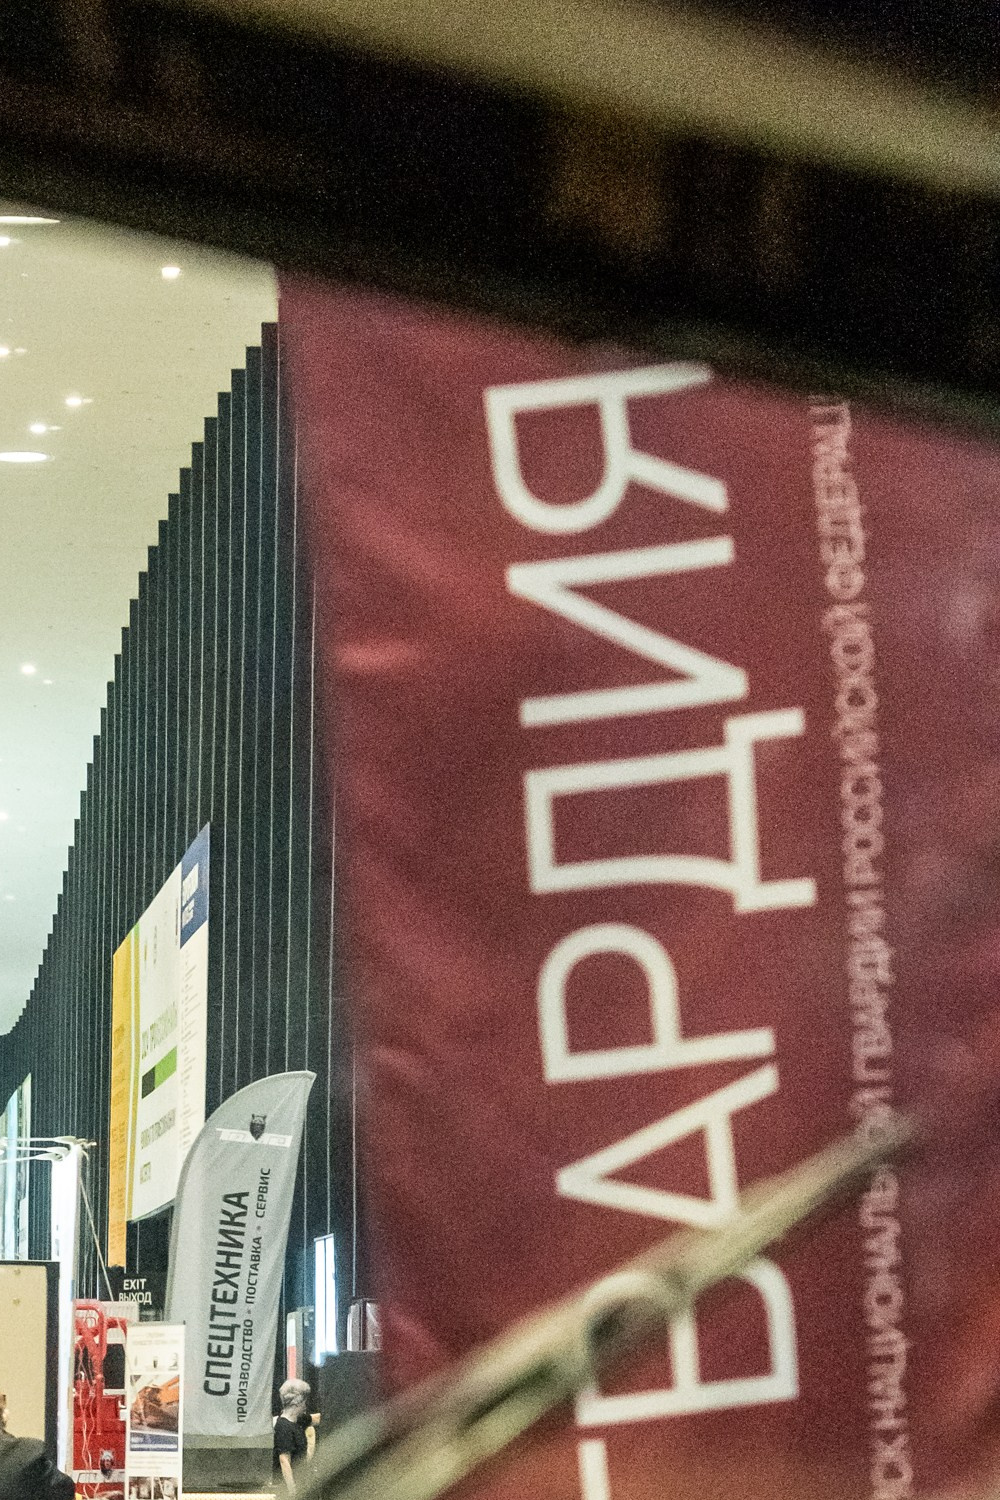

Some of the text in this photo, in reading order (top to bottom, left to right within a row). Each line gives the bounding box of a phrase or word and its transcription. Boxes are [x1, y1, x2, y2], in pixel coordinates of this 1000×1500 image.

[810, 397, 870, 599] ФЕДЕРАЦ
[822, 603, 884, 884] РОССИЙСКОЙ
[847, 892, 895, 1082] ГВАРДИИ
[118, 1291, 152, 1305] ВЫХОД
[123, 1278, 147, 1290] EXIT
[203, 1191, 250, 1398] СПЕЦТЕХНИКА
[237, 1167, 271, 1423] ПРОИЗВОДСТВО ПОСТАВКА СЕРВИС
[850, 1087, 913, 1428] НАЦИОНАЛЬОЙ
